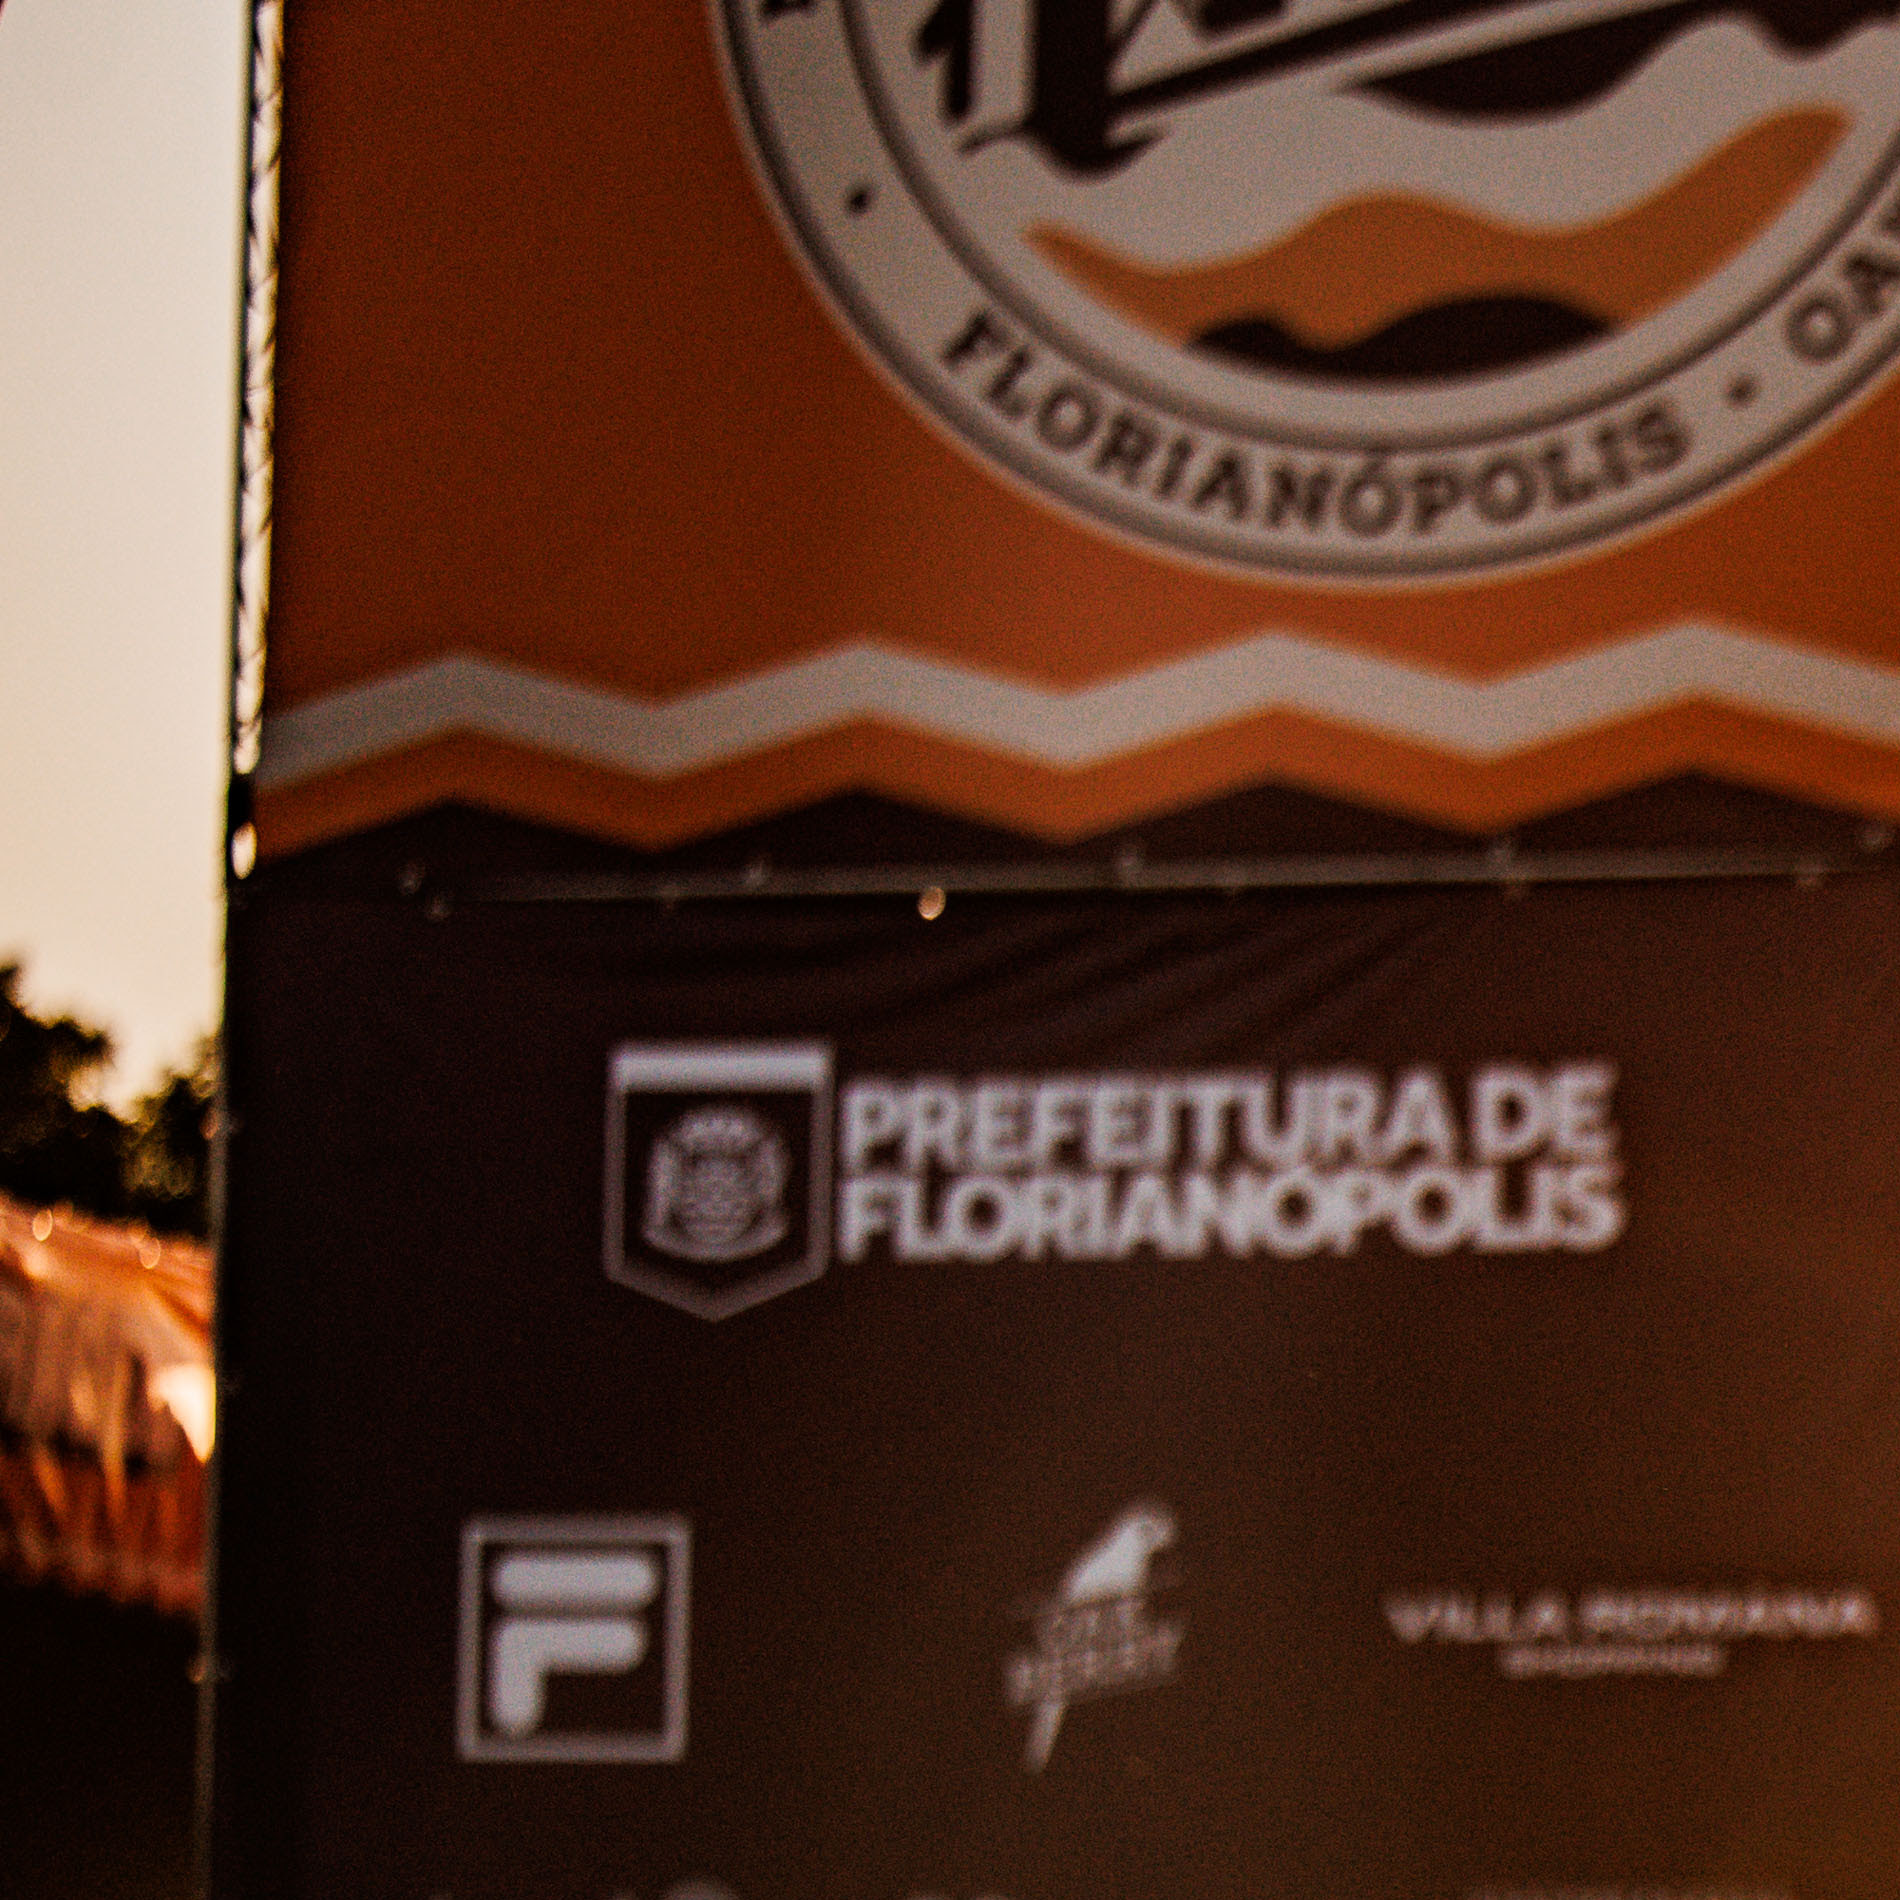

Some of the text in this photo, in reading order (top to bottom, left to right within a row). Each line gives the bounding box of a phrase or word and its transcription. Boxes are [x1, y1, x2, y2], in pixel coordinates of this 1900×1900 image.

[938, 312, 1694, 540] FLORIANÓPOLIS
[836, 1062, 1617, 1170] PREFEITURA DE
[836, 1164, 1624, 1262] FLORIANÓPOLIS
